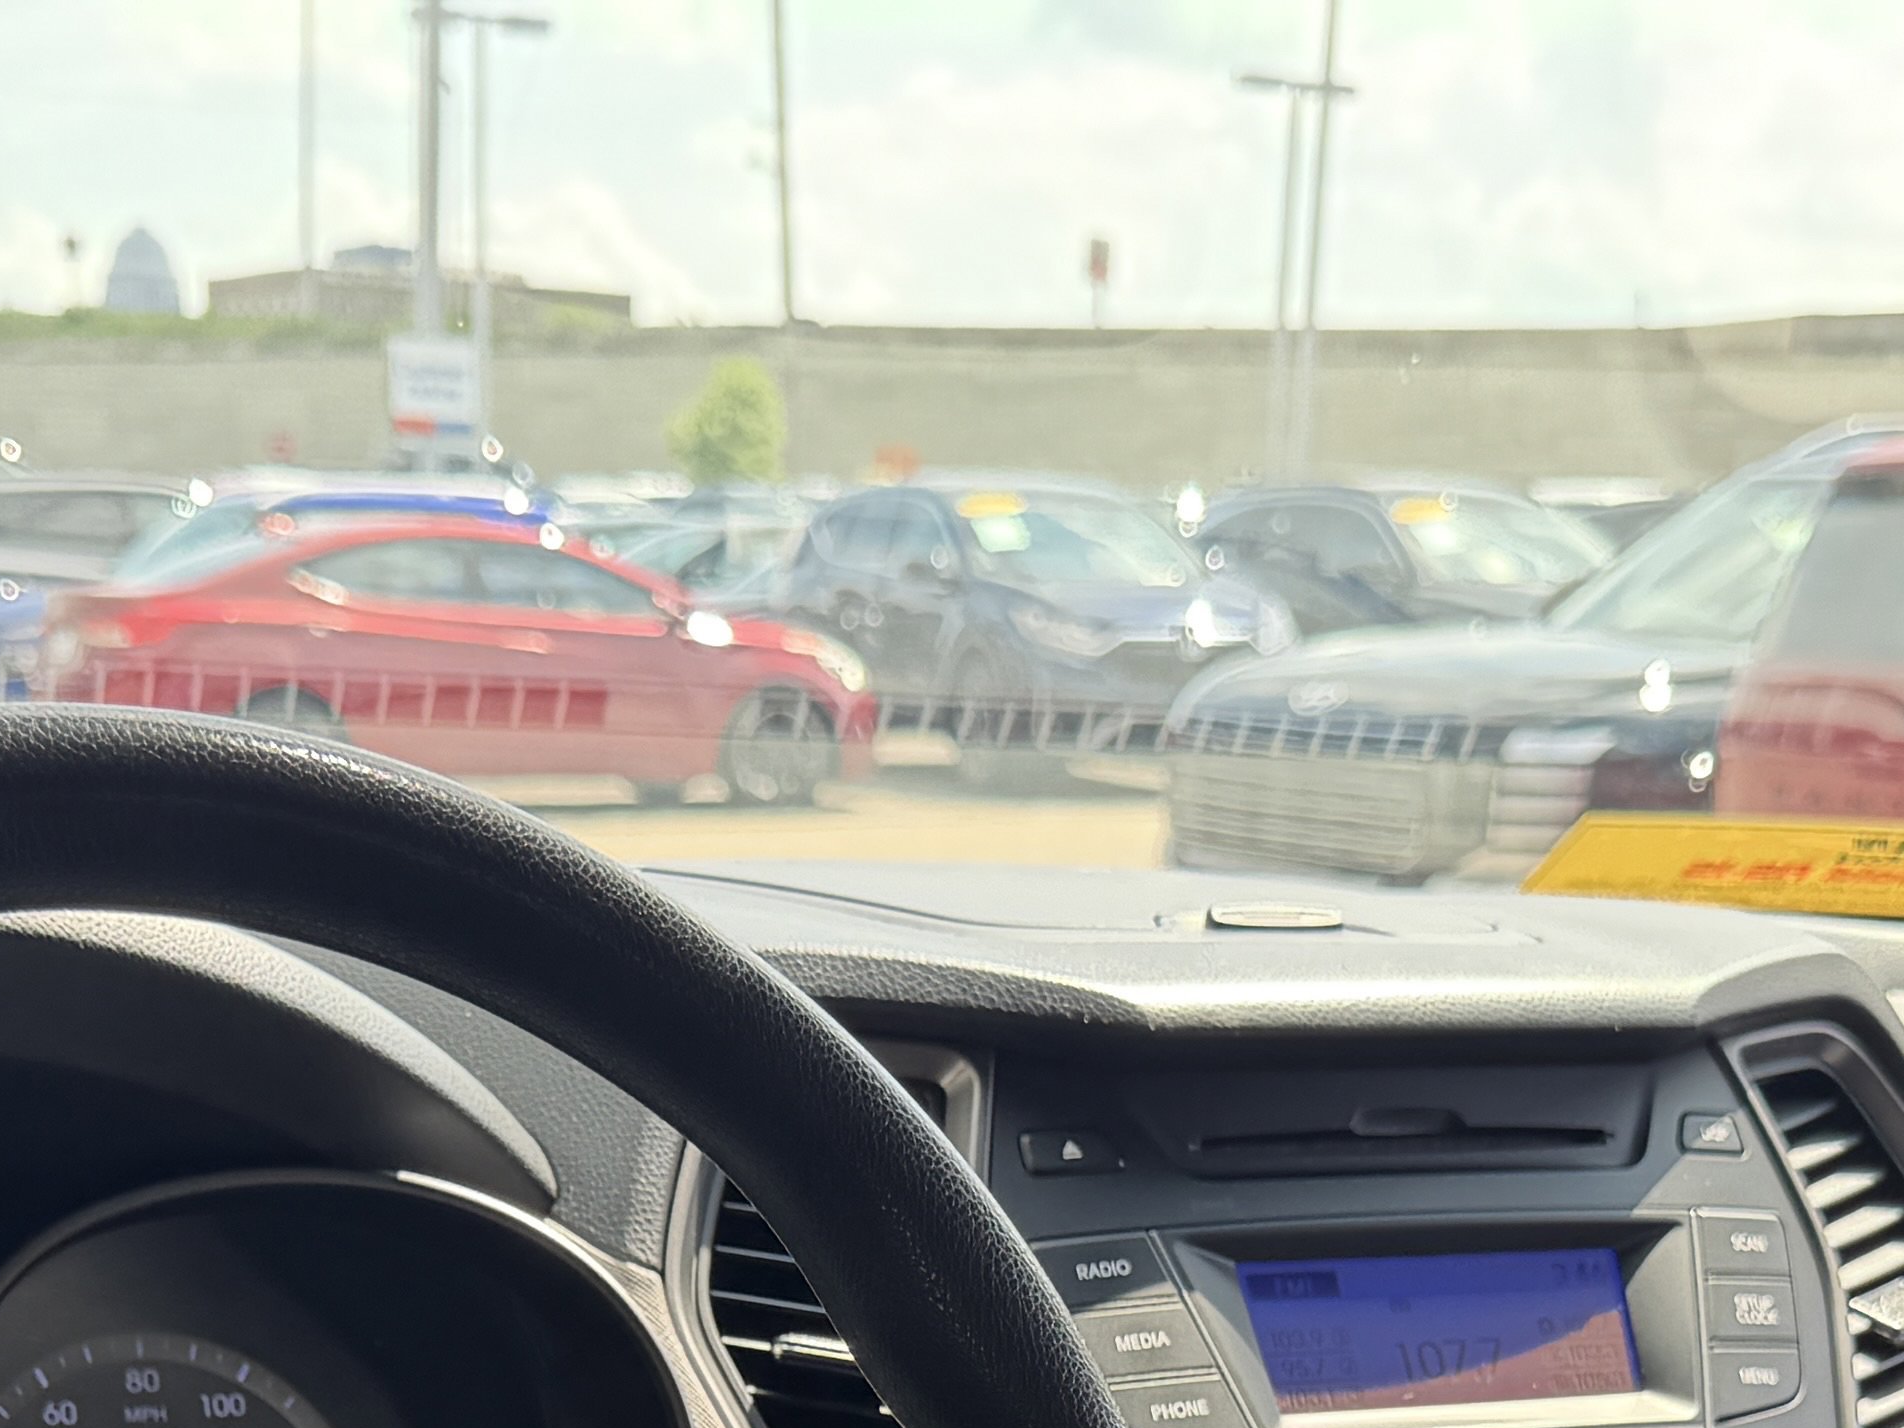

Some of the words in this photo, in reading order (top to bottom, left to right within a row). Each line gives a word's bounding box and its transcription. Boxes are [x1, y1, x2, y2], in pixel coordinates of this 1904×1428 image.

[1730, 1231, 1768, 1252] SCAN
[1076, 1258, 1132, 1281] RADIO
[1736, 1309, 1780, 1325] CLOCK
[1114, 1330, 1171, 1352] MEDIA
[124, 1368, 160, 1393] 80
[1739, 1366, 1779, 1385] MENU
[42, 1400, 77, 1426] 60
[124, 1405, 168, 1423] MPH
[200, 1393, 246, 1418] 100
[1150, 1399, 1210, 1421] PHONE
